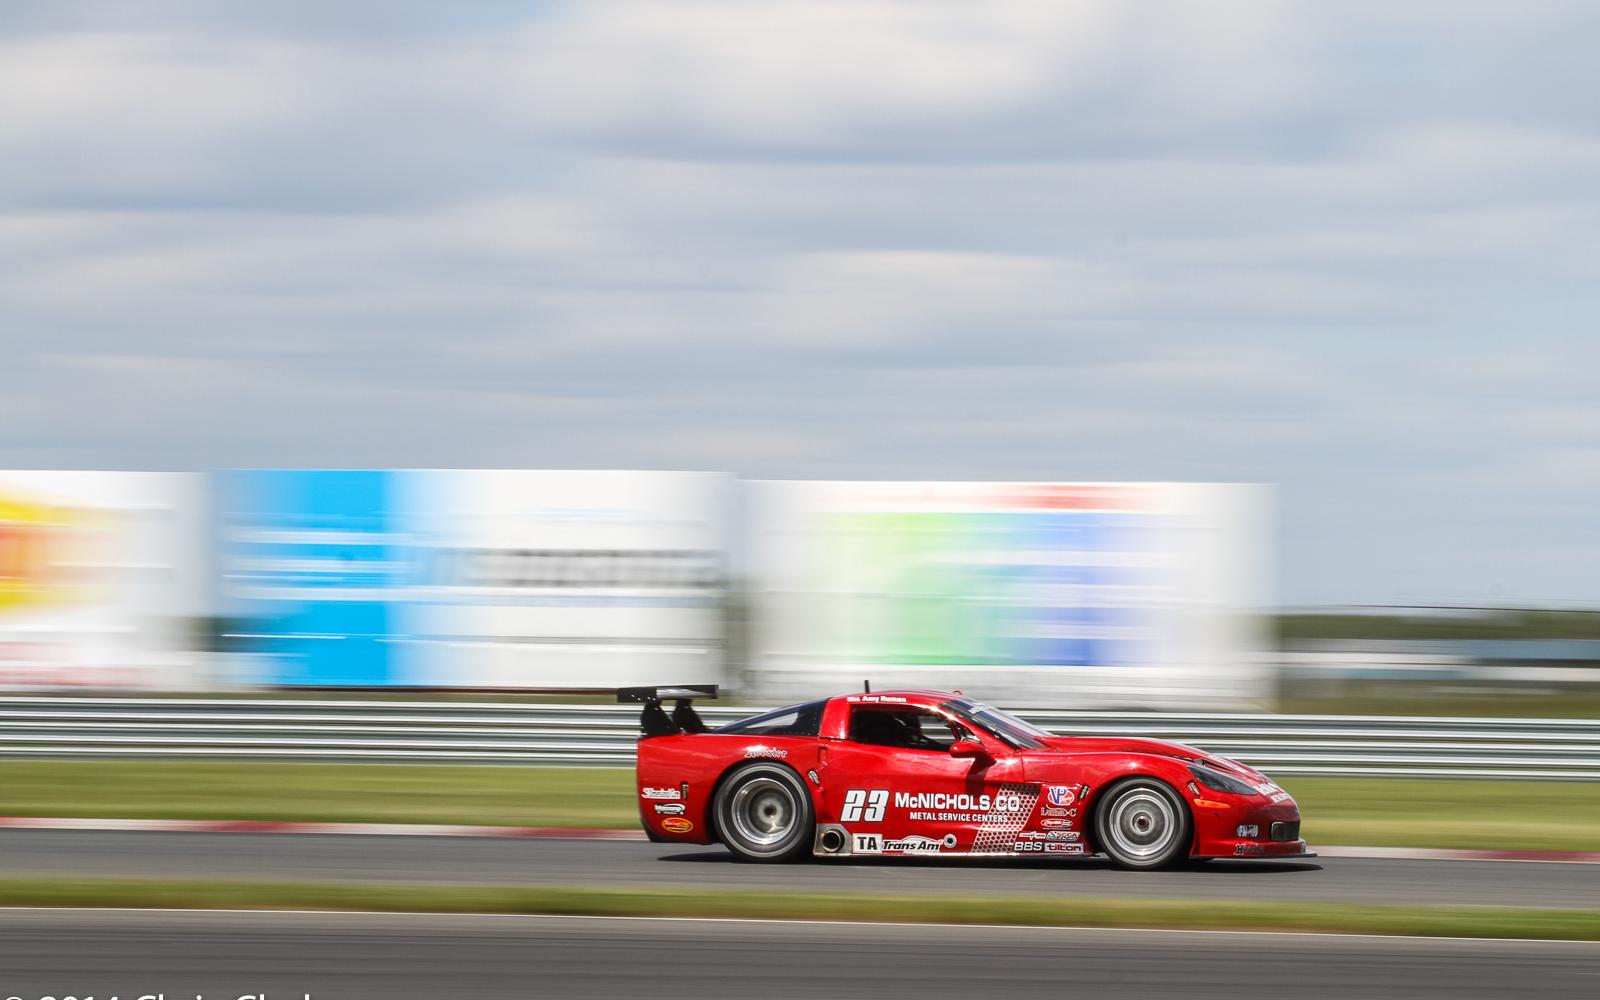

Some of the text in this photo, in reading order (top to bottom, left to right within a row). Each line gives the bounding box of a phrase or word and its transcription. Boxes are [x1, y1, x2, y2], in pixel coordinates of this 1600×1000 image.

[1049, 786, 1067, 804] VP
[840, 789, 890, 822] 23
[895, 793, 990, 811] McNICHOLS
[995, 796, 1024, 812] CO.
[910, 812, 1008, 823] METAL SERVICE CENTERS
[857, 836, 877, 850] TA
[882, 840, 940, 851] Trans Am
[1014, 841, 1043, 851] BBS
[1047, 843, 1082, 851] tilton
